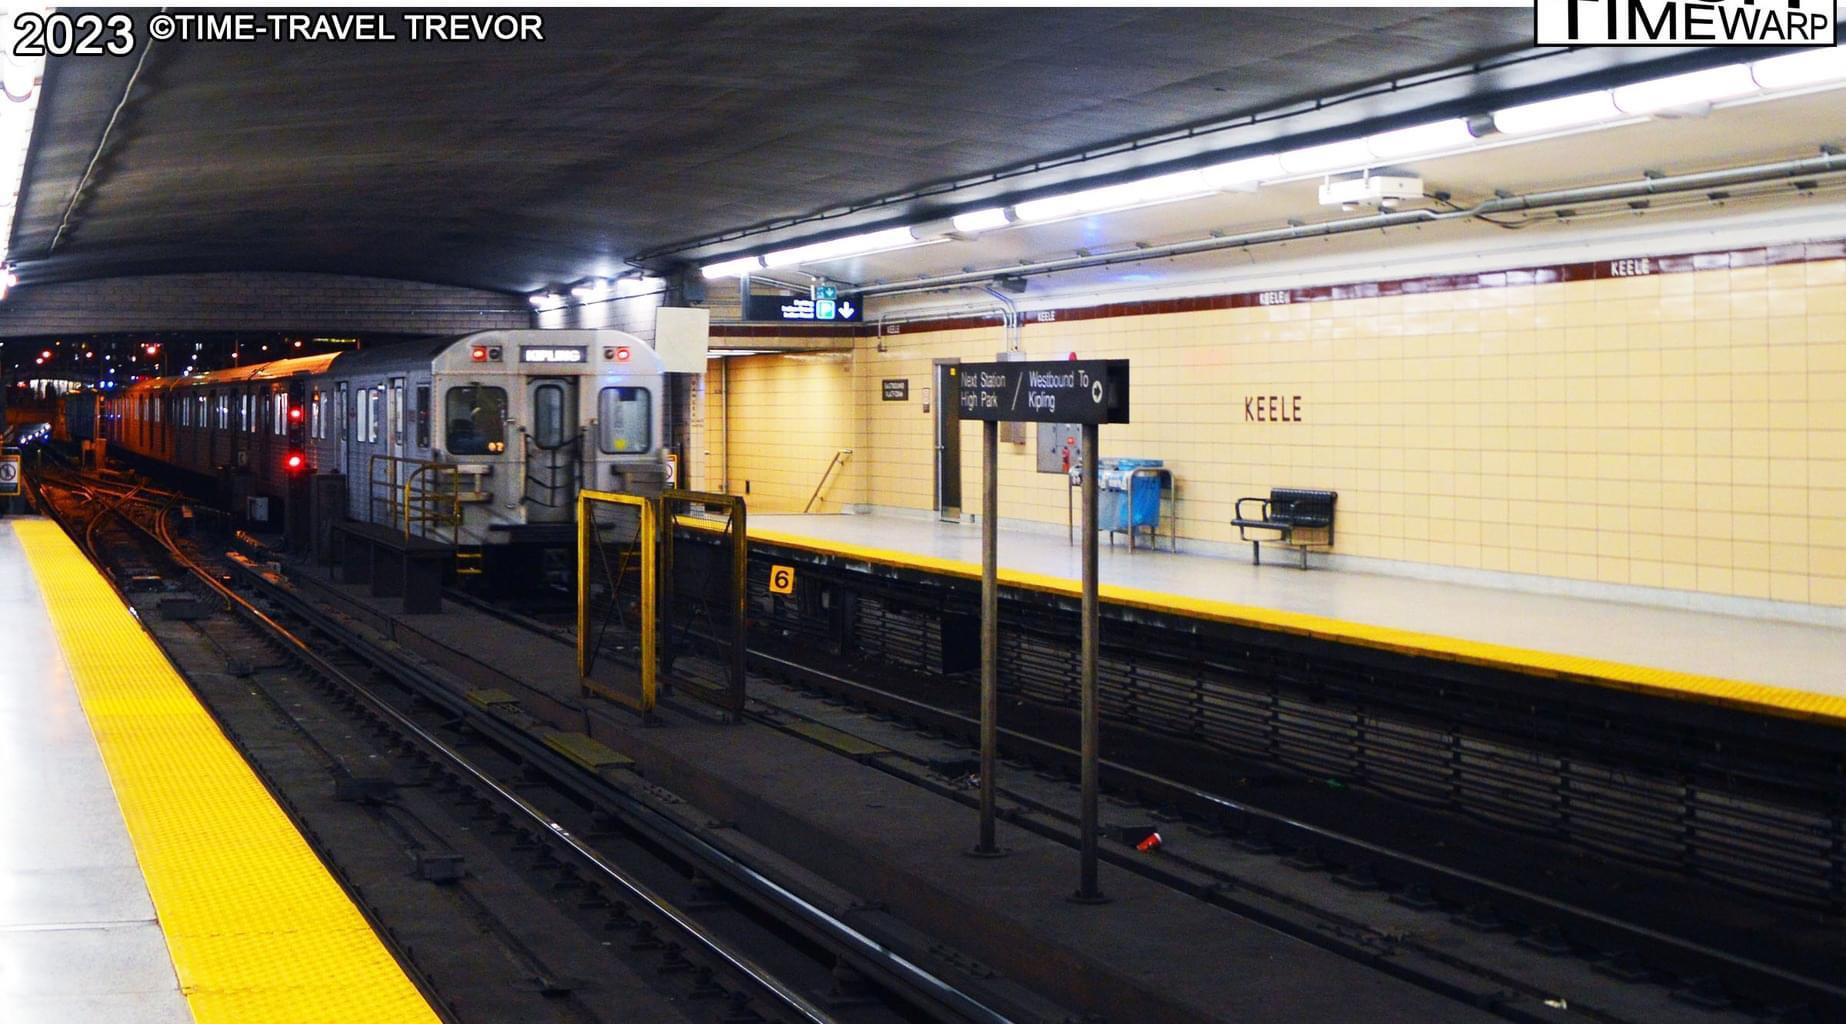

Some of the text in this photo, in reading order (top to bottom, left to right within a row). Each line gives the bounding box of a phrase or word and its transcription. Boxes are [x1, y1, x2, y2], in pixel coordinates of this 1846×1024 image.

[1610, 258, 1649, 276] KEELE
[961, 371, 1006, 388] Next Station
[1029, 369, 1089, 388] Westbound To
[961, 391, 998, 411] High Park
[1028, 390, 1056, 412] Kipling
[1245, 396, 1302, 422] KEELE
[775, 570, 789, 589] 6
